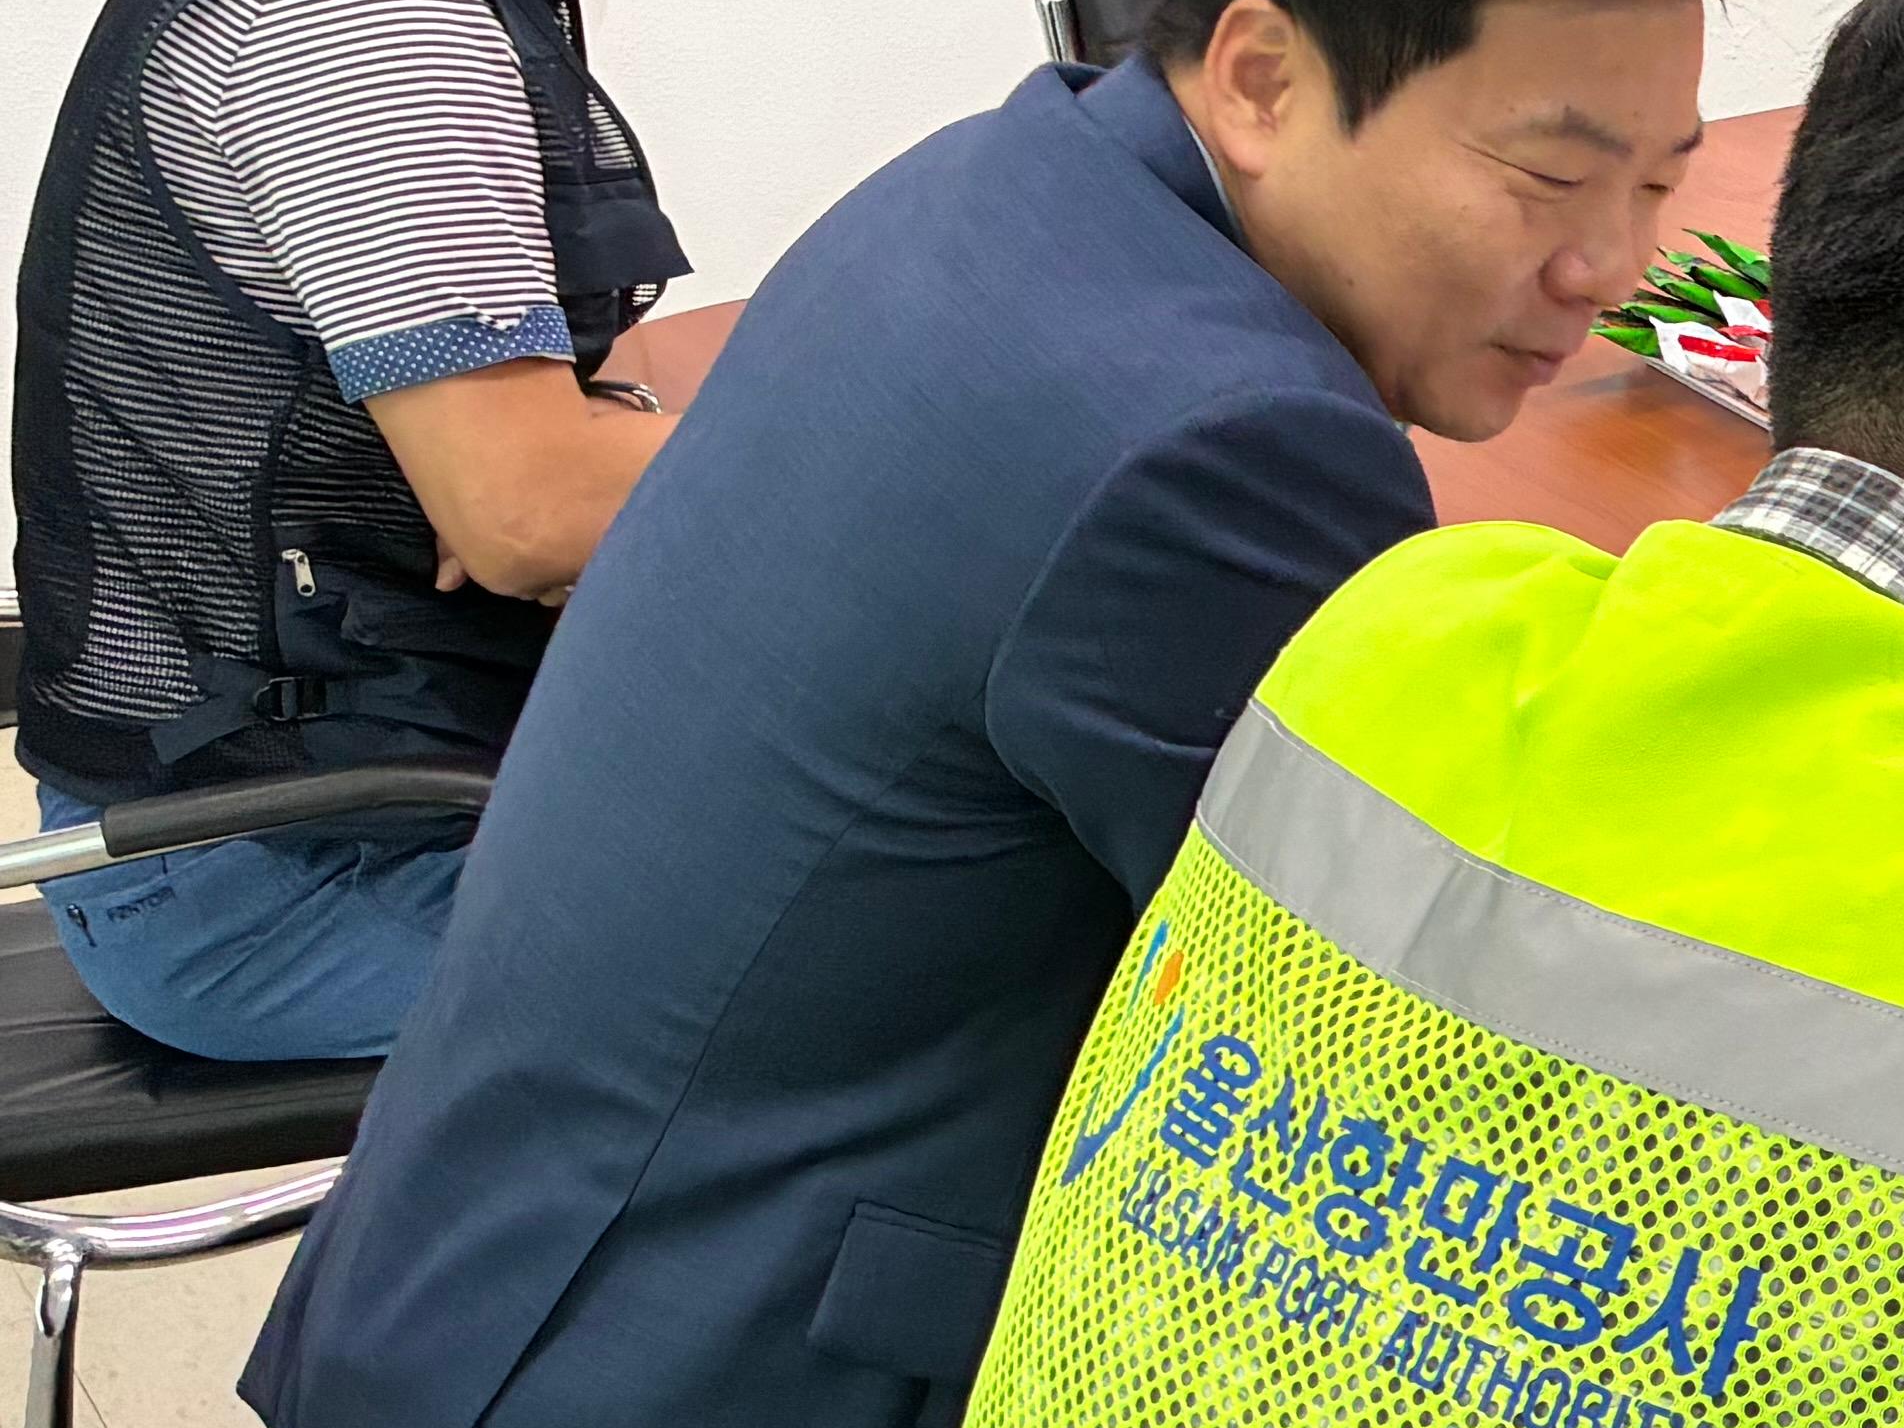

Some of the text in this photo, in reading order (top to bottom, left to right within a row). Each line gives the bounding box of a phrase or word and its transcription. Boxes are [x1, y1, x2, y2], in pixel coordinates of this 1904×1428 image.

[1119, 1158, 1251, 1285] ULSAN
[1249, 1242, 1369, 1347] PORT
[1161, 1034, 1762, 1399] 울산항만공사
